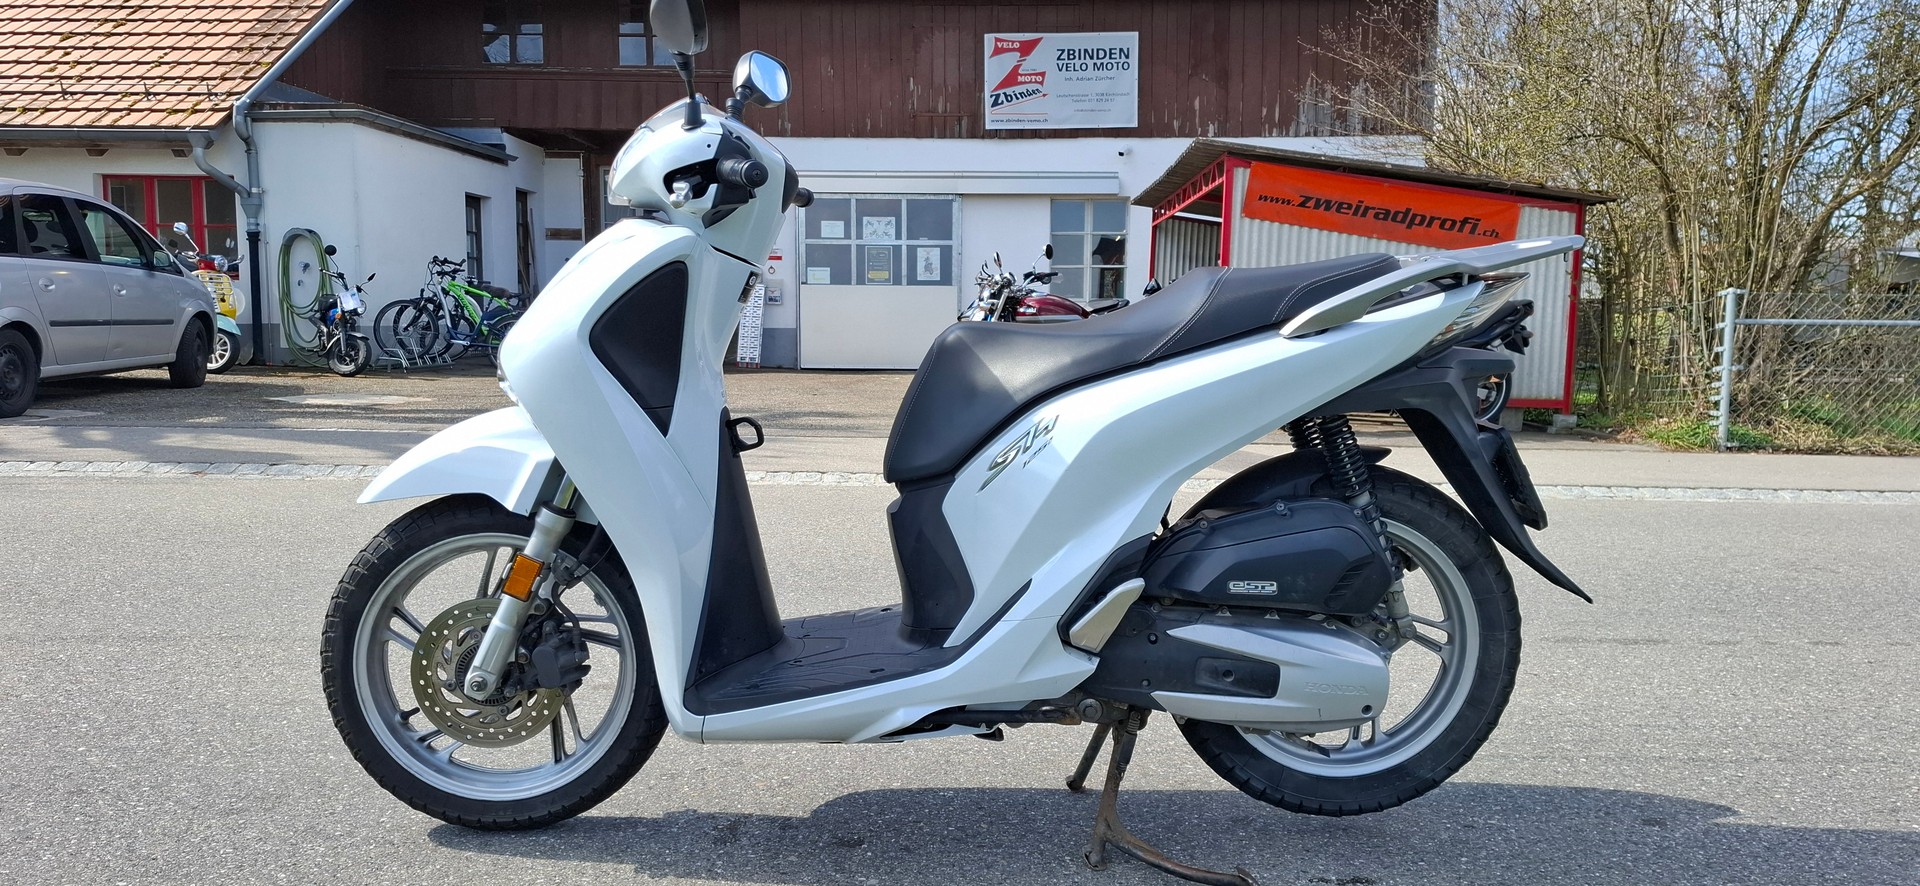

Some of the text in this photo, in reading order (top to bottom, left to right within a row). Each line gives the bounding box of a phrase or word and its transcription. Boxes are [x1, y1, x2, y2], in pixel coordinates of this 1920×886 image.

[996, 41, 1020, 49] VELO
[1056, 47, 1130, 61] ZBINDEN
[1056, 61, 1131, 72] VELO MOTO
[1017, 75, 1043, 83] MOTO
[990, 88, 1043, 108] Zbinden
[1304, 681, 1369, 696] HONDA
